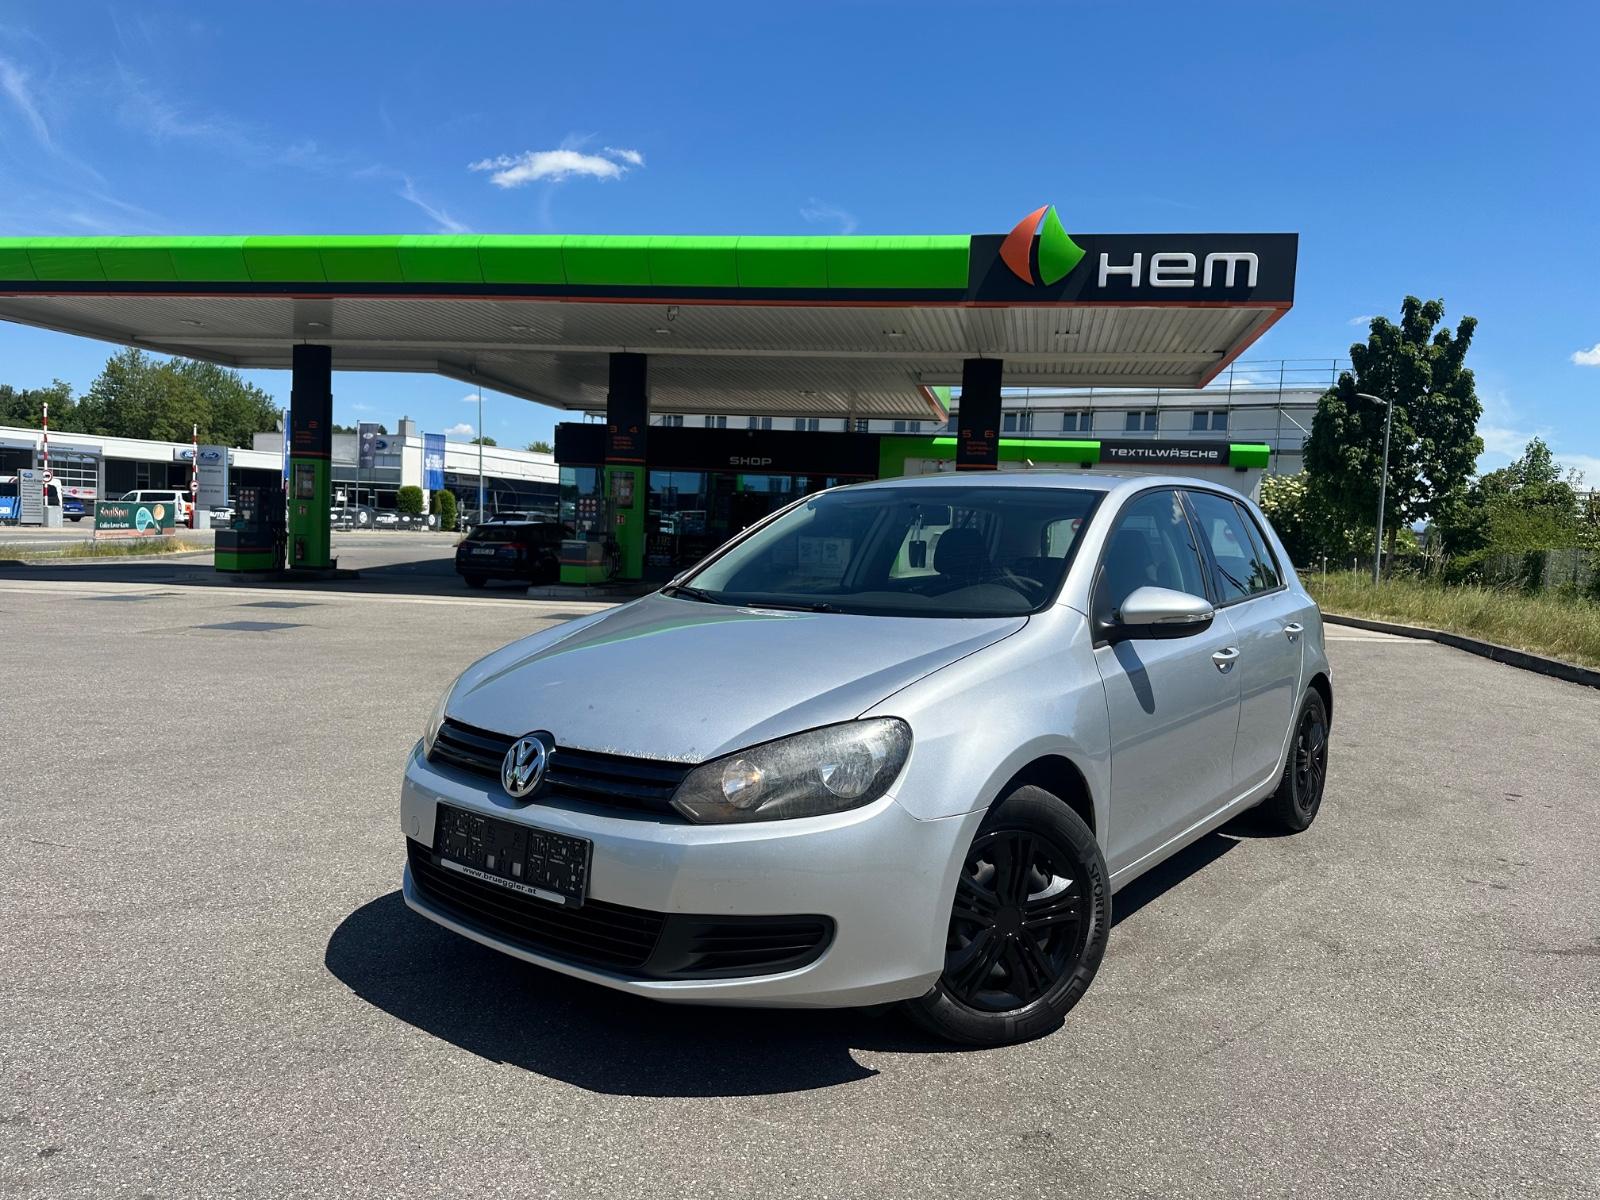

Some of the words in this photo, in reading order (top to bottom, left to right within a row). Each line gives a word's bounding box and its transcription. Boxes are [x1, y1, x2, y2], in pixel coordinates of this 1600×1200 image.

[961, 430, 972, 438] 5
[728, 456, 773, 466] SHOP
[462, 866, 537, 895] www.brueggler.at
